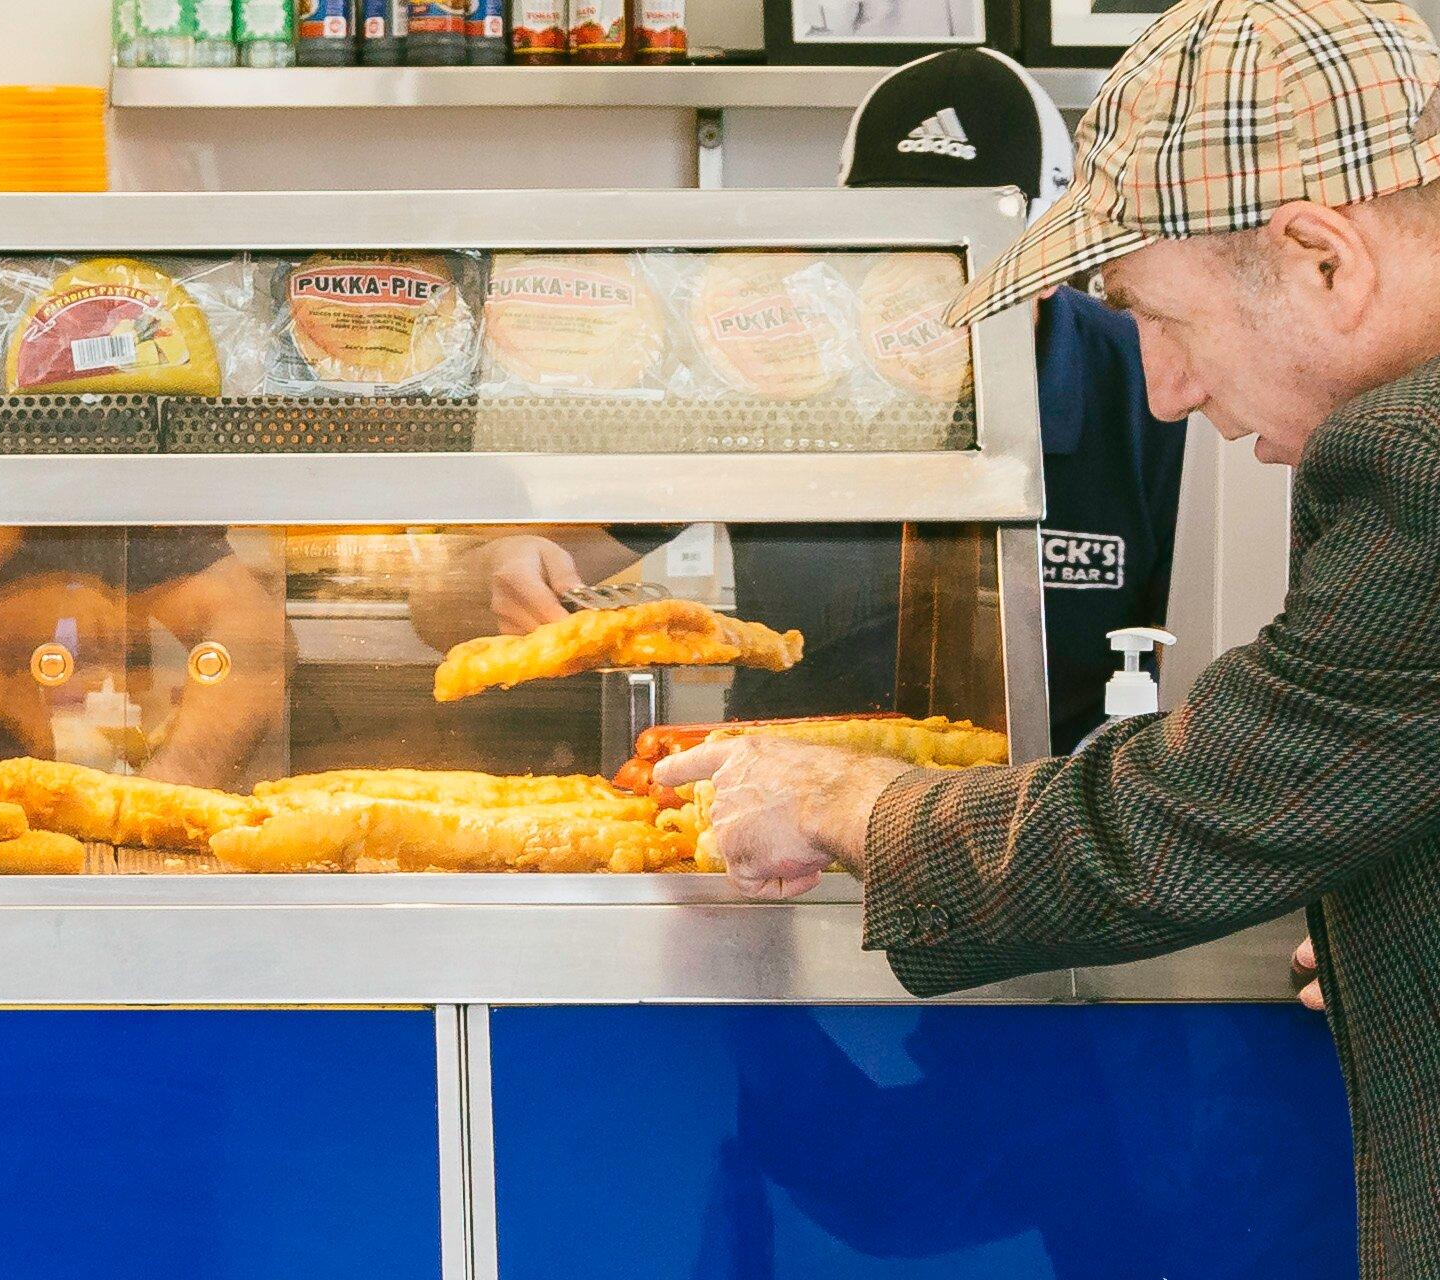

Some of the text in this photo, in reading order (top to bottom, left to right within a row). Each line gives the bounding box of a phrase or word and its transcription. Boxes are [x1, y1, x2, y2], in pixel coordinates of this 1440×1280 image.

[897, 137, 977, 160] adidas
[487, 277, 630, 301] PUKKA-PIES
[1043, 537, 1117, 566] CK'S
[1061, 567, 1099, 581] BAR
